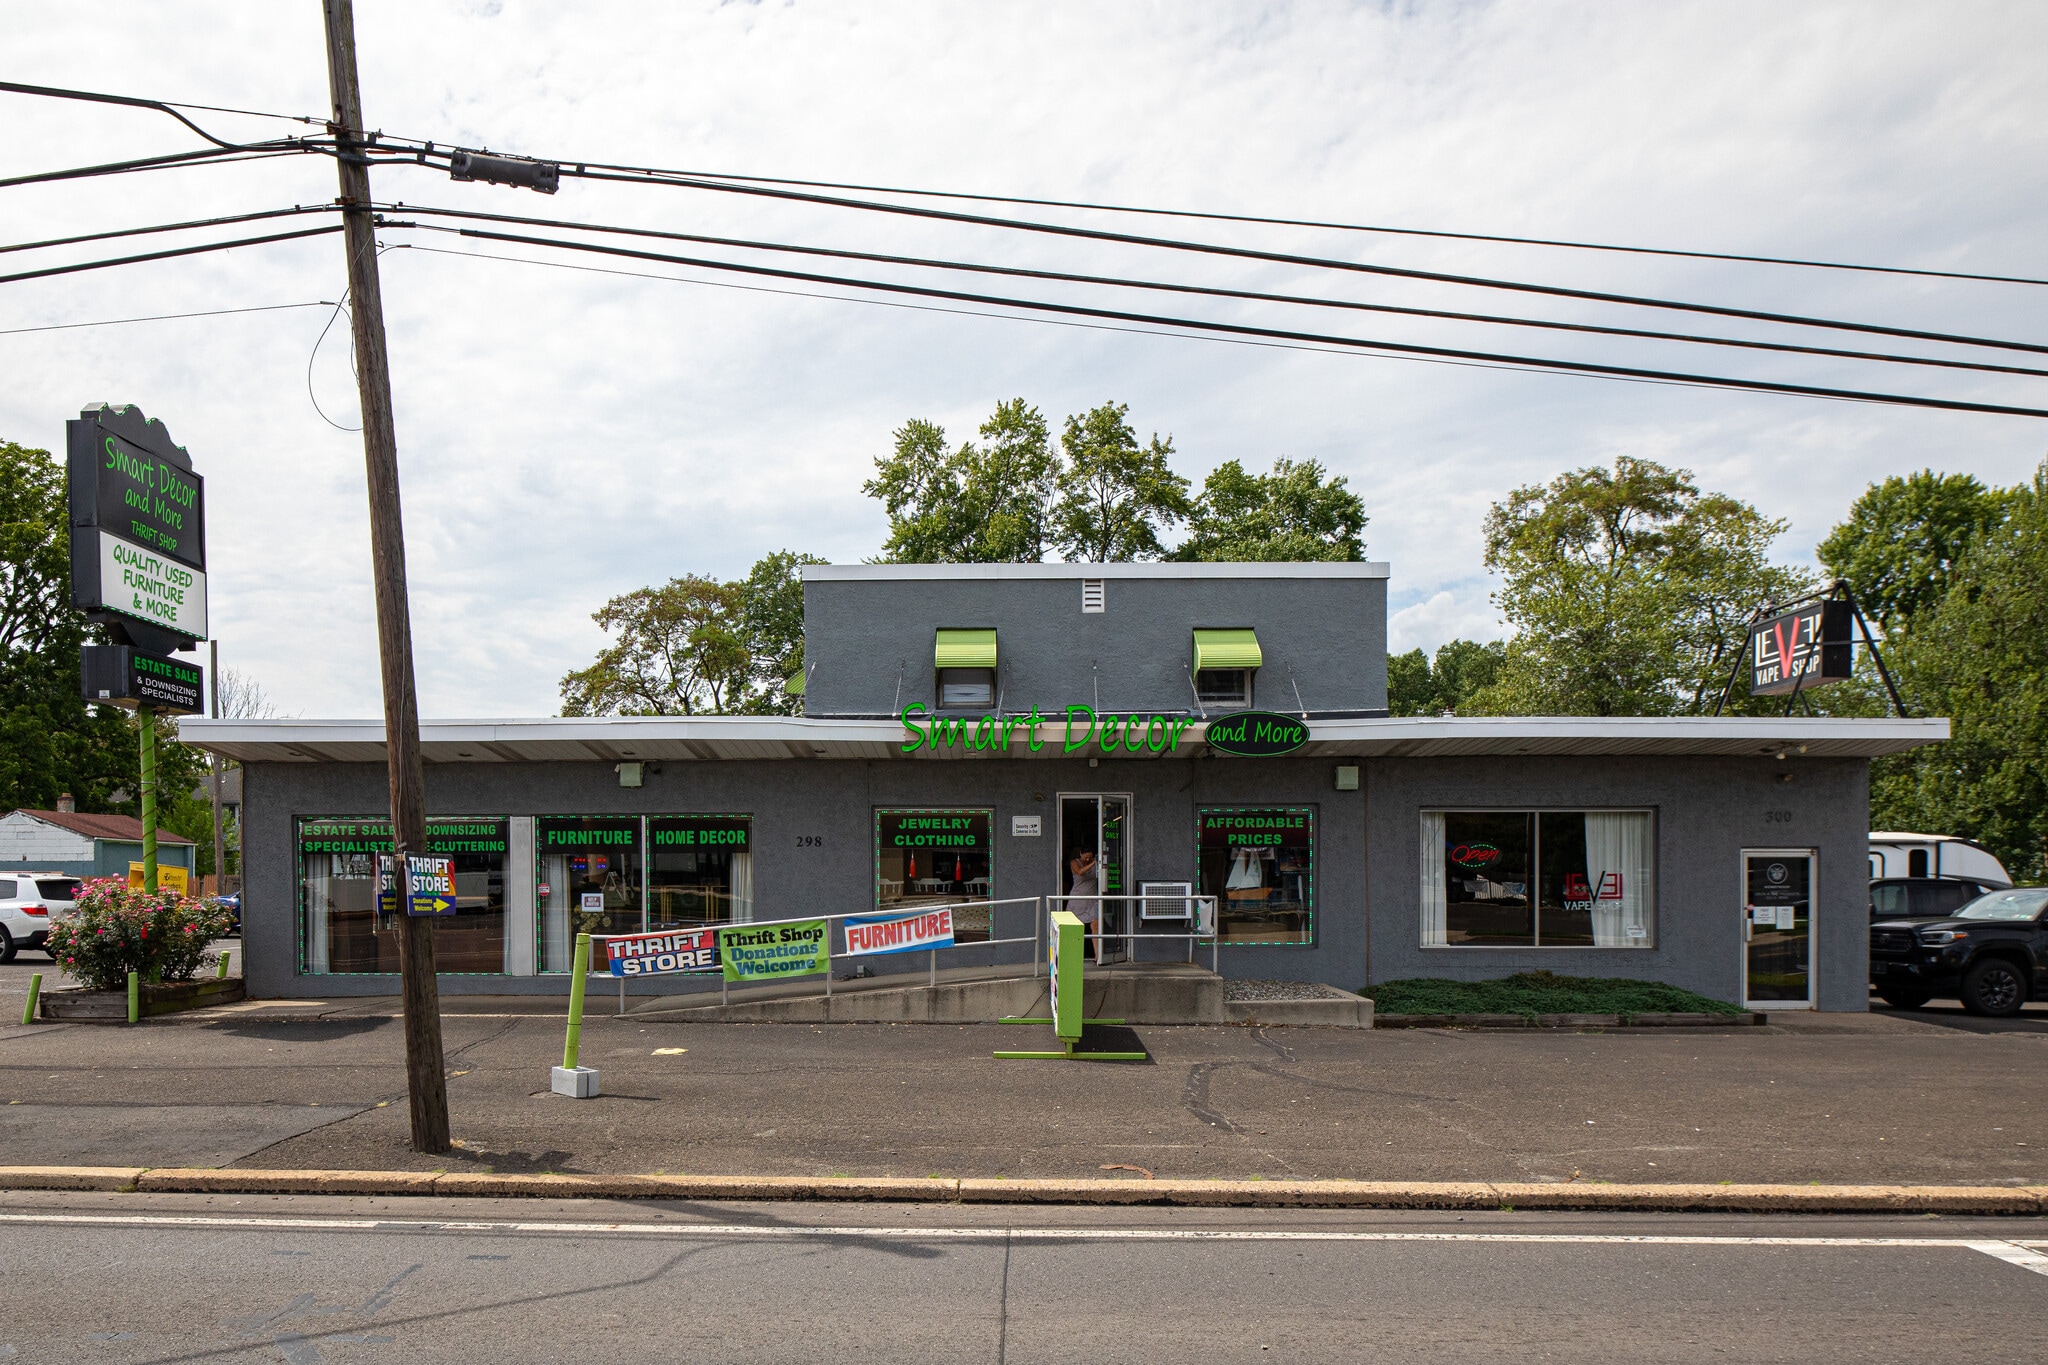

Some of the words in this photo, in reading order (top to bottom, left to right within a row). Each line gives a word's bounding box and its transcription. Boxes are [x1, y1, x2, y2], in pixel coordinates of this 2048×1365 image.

[105, 437, 154, 488] Smart
[159, 464, 197, 509] Décor
[125, 488, 150, 514] and
[155, 497, 183, 530] More
[131, 520, 158, 544] THRIFT
[159, 532, 178, 552] SHOP
[113, 544, 163, 577] QUALITY
[165, 565, 193, 588] USED
[124, 568, 184, 605] FURNITURE
[133, 592, 142, 610] &
[146, 597, 177, 622] MORE
[134, 656, 172, 677] ESTATE
[175, 667, 198, 684] SALE
[1756, 665, 1779, 685] VAPE
[137, 676, 143, 684] &
[145, 678, 197, 697] DOWNSIZING
[141, 687, 194, 705] SPECIALISTS
[900, 702, 1048, 753] Smart
[1063, 704, 1195, 754] Decor
[1210, 718, 1247, 743] and
[1254, 720, 1303, 744] More
[304, 825, 356, 836] ESTATE
[361, 825, 394, 836] SALE
[898, 819, 972, 829] JEWELRY
[1206, 818, 1304, 828] AFFORDABLE
[305, 841, 395, 852] SPECIALISTS
[548, 830, 633, 845] FURNITURE
[655, 830, 695, 845] HOME
[700, 830, 746, 844] DECOR
[796, 836, 822, 847] 298
[894, 835, 976, 845] CLOTHING
[1228, 834, 1282, 845] PRICES
[1451, 845, 1500, 863] Open
[409, 857, 449, 874] THRIFT
[412, 875, 449, 892] STORE
[1564, 901, 1591, 911] VAPE
[1596, 901, 1623, 911] SHOP
[723, 930, 776, 947] Thrift
[780, 928, 823, 945] Shop
[848, 911, 951, 951] FURNITURE
[608, 932, 704, 958] THRIFT
[730, 943, 819, 962] Donations
[622, 949, 713, 974] STORE
[735, 958, 816, 976] Welcome
